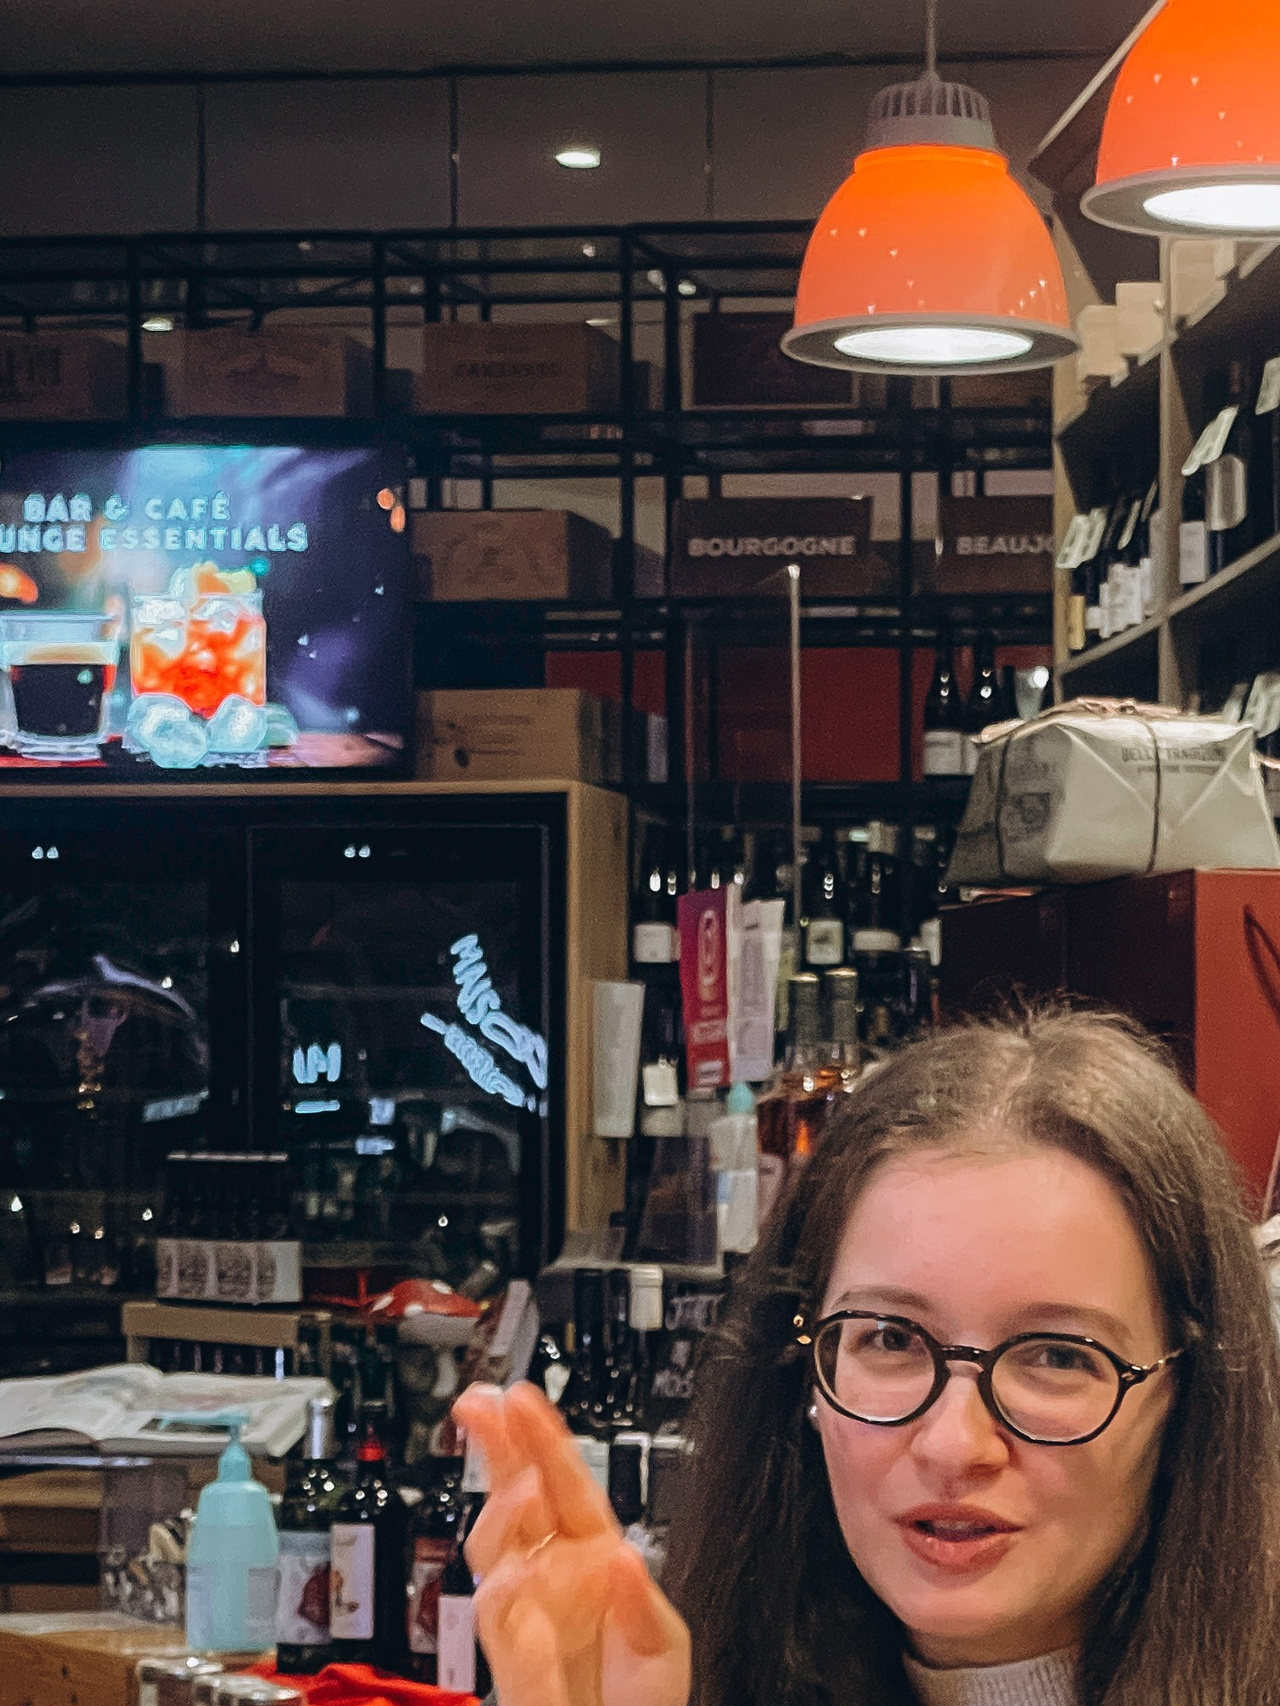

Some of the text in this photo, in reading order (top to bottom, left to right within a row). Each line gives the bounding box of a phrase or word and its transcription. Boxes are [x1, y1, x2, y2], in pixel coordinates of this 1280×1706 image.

[23, 493, 92, 522] BAR
[145, 490, 231, 521] CAFÉ
[0, 521, 309, 552] UNGE ESSENTIALS
[687, 535, 857, 557] BOURGOGNE
[956, 535, 1054, 556] BEAUJO
